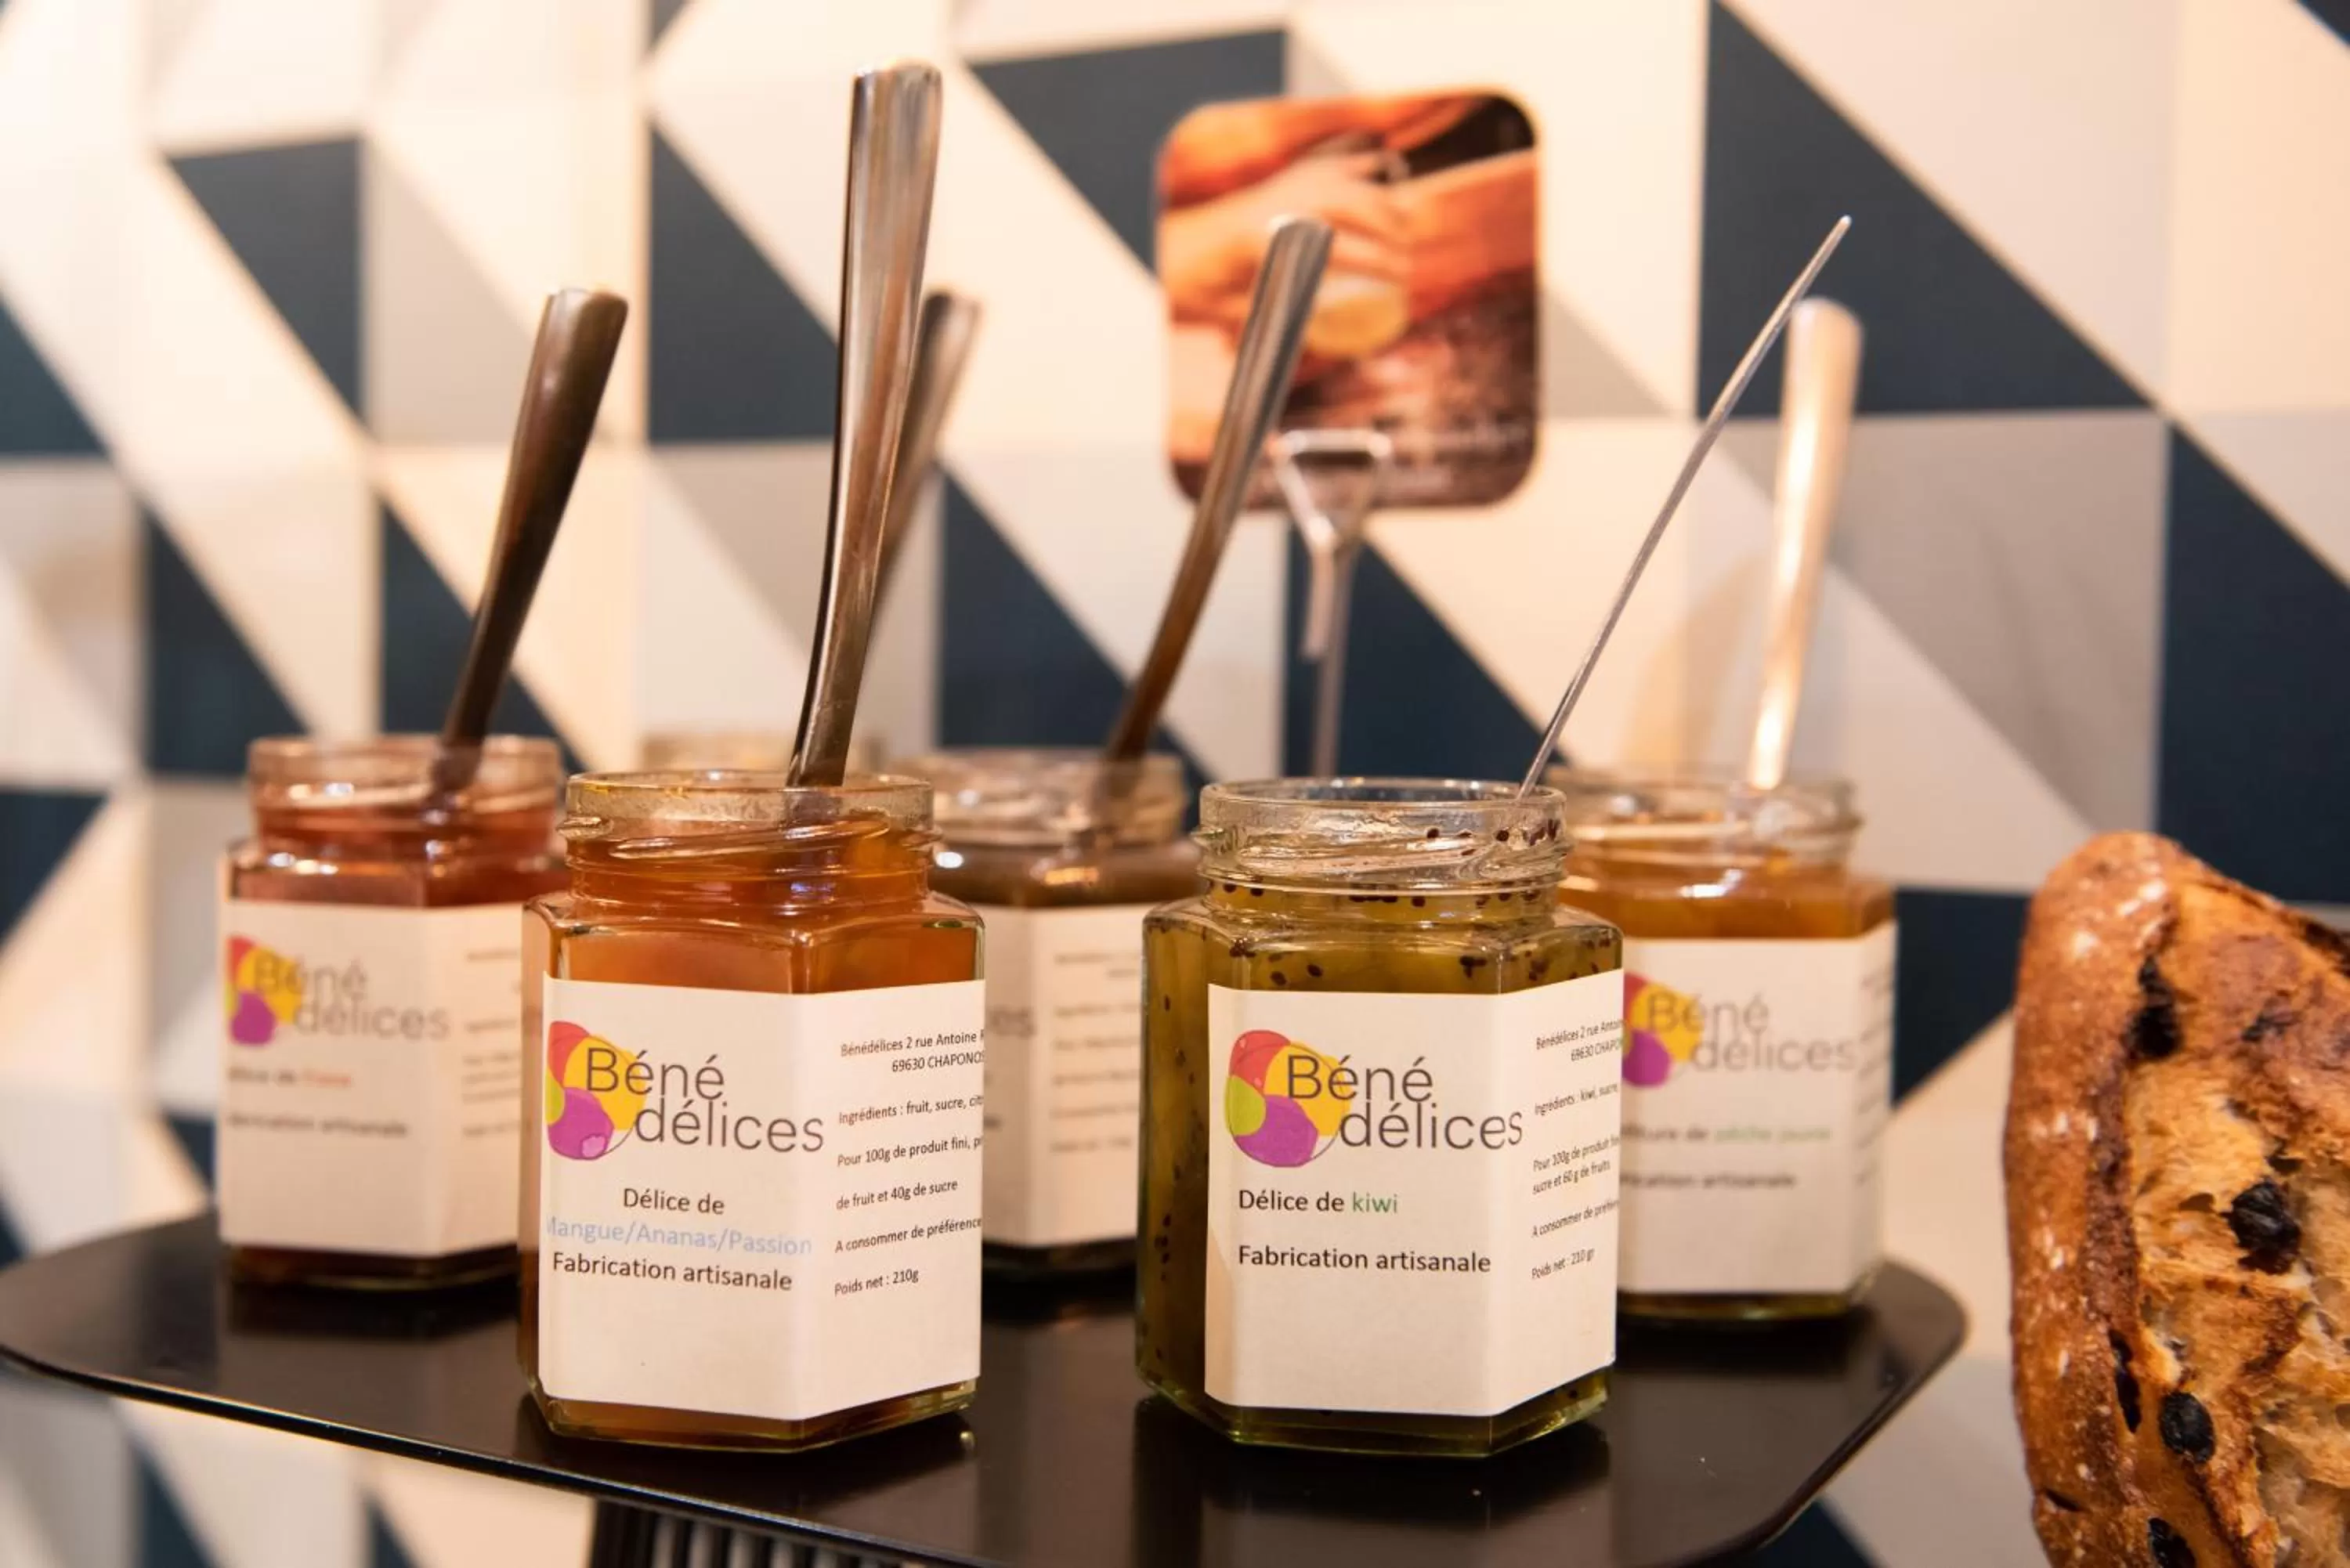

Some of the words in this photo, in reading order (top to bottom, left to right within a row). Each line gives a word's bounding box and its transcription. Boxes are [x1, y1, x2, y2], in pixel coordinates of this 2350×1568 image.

[1647, 988, 1770, 1034] Béné
[841, 1039, 903, 1057] Bénédélices
[906, 1036, 913, 1050] 2
[915, 1038, 933, 1048] rue
[936, 1031, 978, 1046] Antoine
[1691, 1034, 1858, 1073] délices
[588, 1047, 725, 1100] Béné
[891, 1057, 925, 1072] 69630
[1288, 1054, 1433, 1102] Béné
[635, 1097, 823, 1152] délices
[839, 1105, 898, 1126] Ingrédients
[906, 1100, 933, 1115] fruit,
[935, 1097, 967, 1112] sucre,
[1340, 1101, 1522, 1150] délices
[837, 1153, 862, 1167] Pour
[866, 1147, 891, 1163] 100g
[893, 1144, 907, 1158] de
[909, 1140, 949, 1159] produit
[624, 1187, 690, 1212] Délice
[697, 1192, 725, 1214] de
[836, 1195, 850, 1210] de
[852, 1192, 874, 1207] fruit
[877, 1191, 888, 1203] et
[891, 1185, 911, 1201] 40g
[913, 1182, 927, 1196] de
[929, 1180, 958, 1194] sucre
[1238, 1189, 1309, 1212] Délice
[1316, 1190, 1345, 1212] de
[1352, 1190, 1398, 1213] kiwi
[834, 1240, 844, 1253] A
[845, 1230, 909, 1252] consommer
[911, 1224, 924, 1239] de
[553, 1251, 676, 1281] Fabrication
[683, 1265, 792, 1291] artisanale
[1238, 1245, 1368, 1270] Fabrication
[1376, 1251, 1491, 1273] artisanale
[834, 1277, 862, 1297] Poids
[866, 1274, 884, 1290] net
[892, 1268, 919, 1284] 210g
